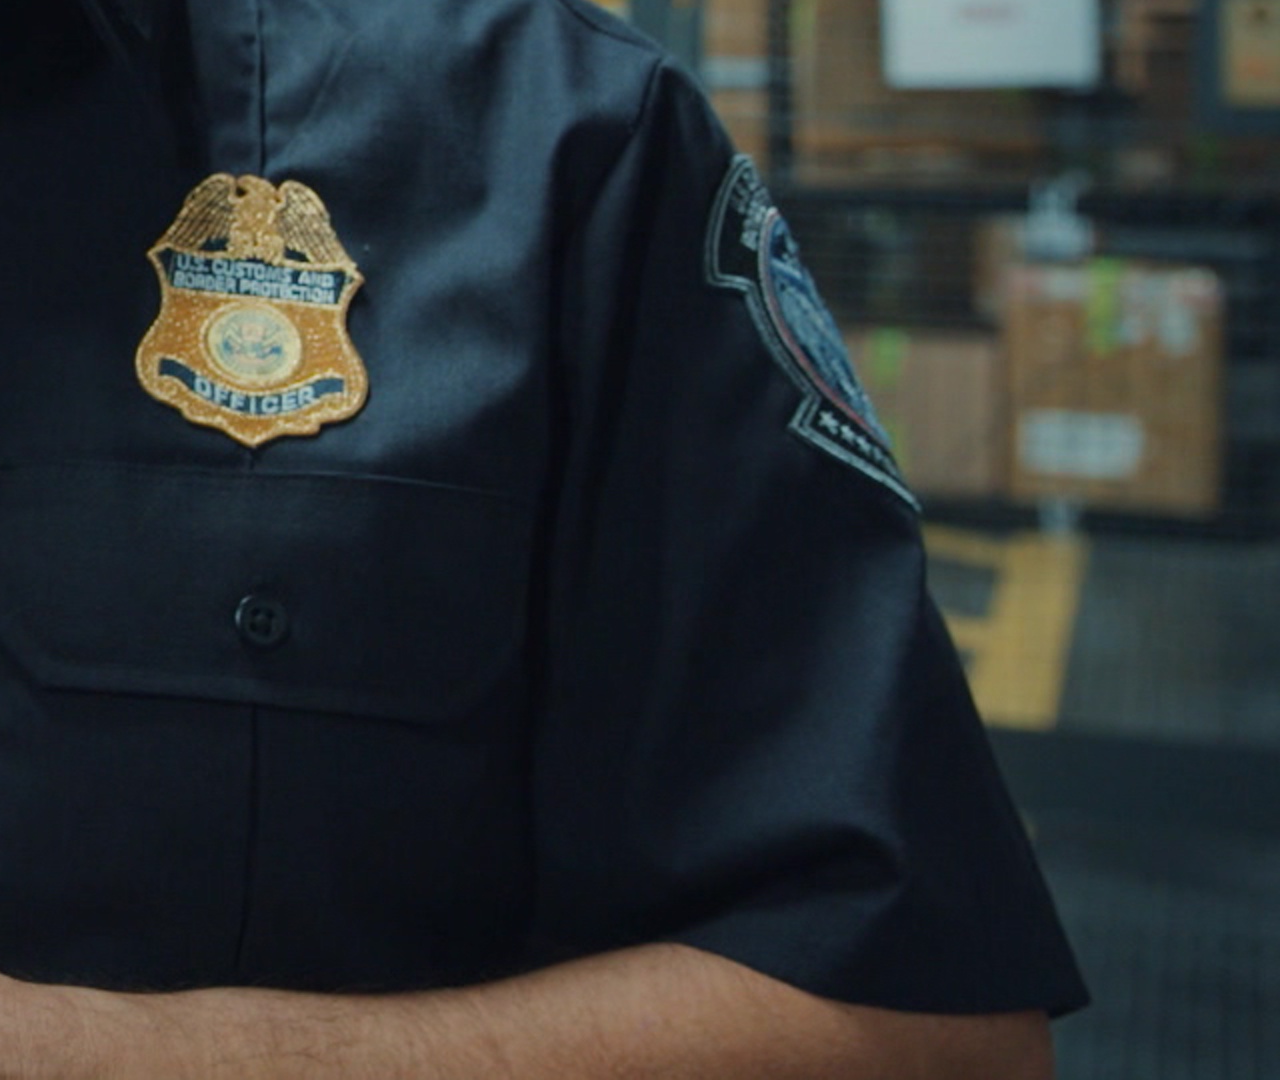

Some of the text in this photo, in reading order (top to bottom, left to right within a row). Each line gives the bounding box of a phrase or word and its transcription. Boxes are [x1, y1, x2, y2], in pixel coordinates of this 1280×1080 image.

[173, 270, 335, 304] BORDER PROTECTION
[177, 253, 334, 287] U.S. CUSTOMS AND
[194, 376, 317, 414] OFFICER
